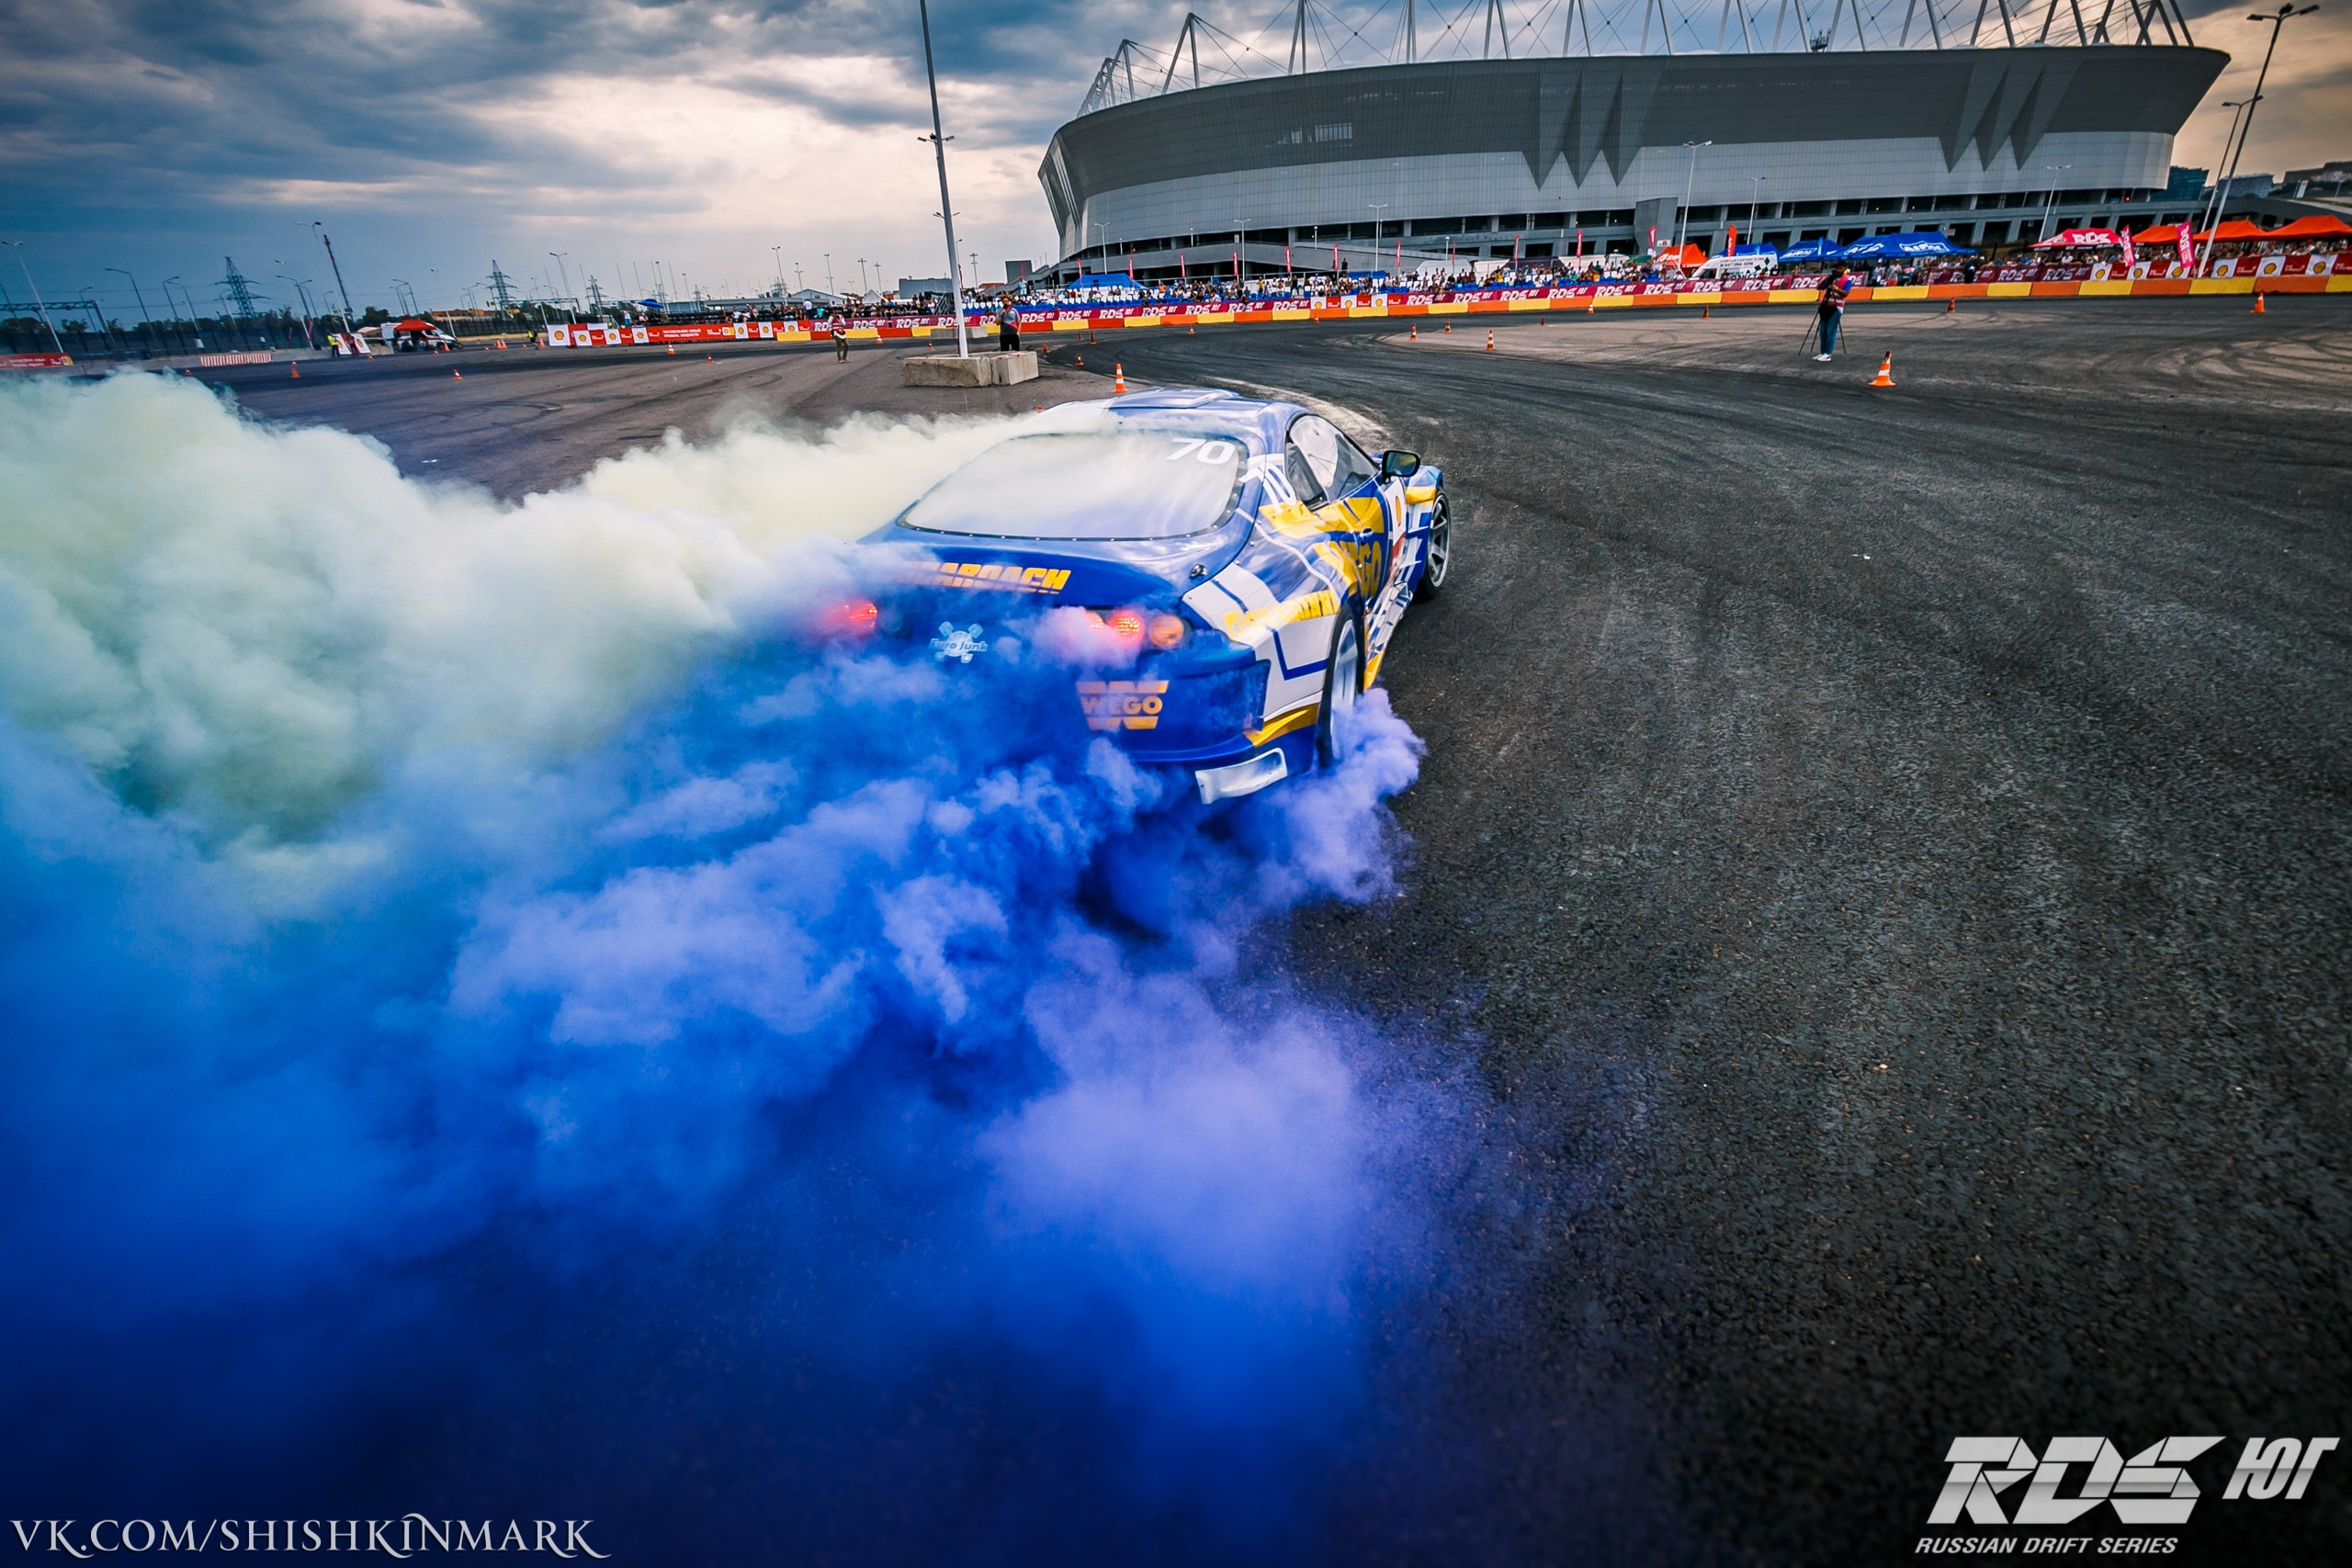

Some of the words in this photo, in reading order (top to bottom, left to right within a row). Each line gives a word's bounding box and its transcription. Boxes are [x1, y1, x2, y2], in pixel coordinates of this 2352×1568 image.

[2073, 231, 2110, 244] RDS
[1950, 271, 1981, 282] RS
[1997, 270, 2026, 281] RDS
[2042, 268, 2075, 281] RDS
[1691, 281, 1723, 293] RDS
[1741, 279, 1771, 291] RDS
[1791, 277, 1821, 288] RDS
[1546, 288, 1576, 299] RDS
[1594, 286, 1623, 297] RDS
[1643, 283, 1672, 295] RDS
[1406, 294, 1434, 305] RDS
[1453, 292, 1481, 303] RDS
[1499, 289, 1528, 301] RDS
[1185, 304, 1210, 315] RDS
[1272, 300, 1298, 311] RDS
[1021, 312, 1046, 322] RDS
[1058, 310, 1082, 321] RDS
[1099, 308, 1125, 319] RDS
[1141, 306, 1167, 317] RDS
[854, 320, 876, 330] RDS
[896, 318, 920, 328] RDS
[979, 315, 996, 324] RD
[1166, 437, 1236, 465] 70
[929, 637, 957, 650] Euro
[959, 641, 989, 652] Junk
[1080, 695, 1163, 716] WEGO
